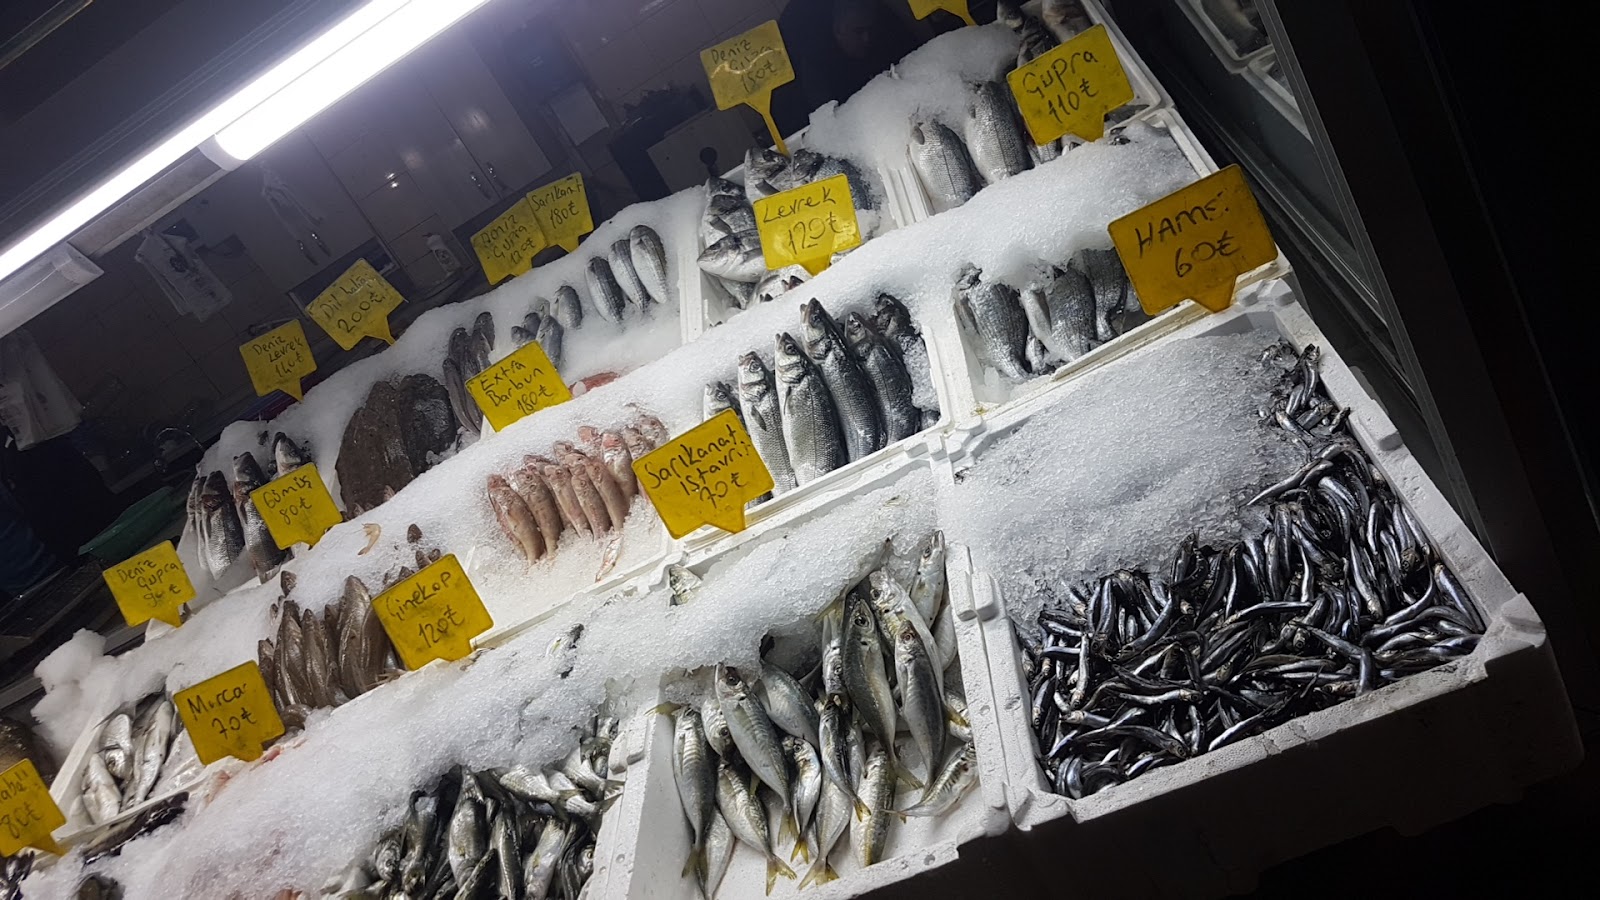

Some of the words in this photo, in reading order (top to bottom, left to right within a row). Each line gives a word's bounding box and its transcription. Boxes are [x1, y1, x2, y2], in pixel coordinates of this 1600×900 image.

[711, 39, 751, 65] Deniz
[763, 186, 836, 223] Levrek
[319, 293, 342, 319] Dil
[252, 335, 286, 356] Deniz
[268, 336, 304, 363] Levrek
[480, 360, 526, 392] Extra
[485, 367, 544, 408] Barbun
[117, 559, 157, 583] Deniz
